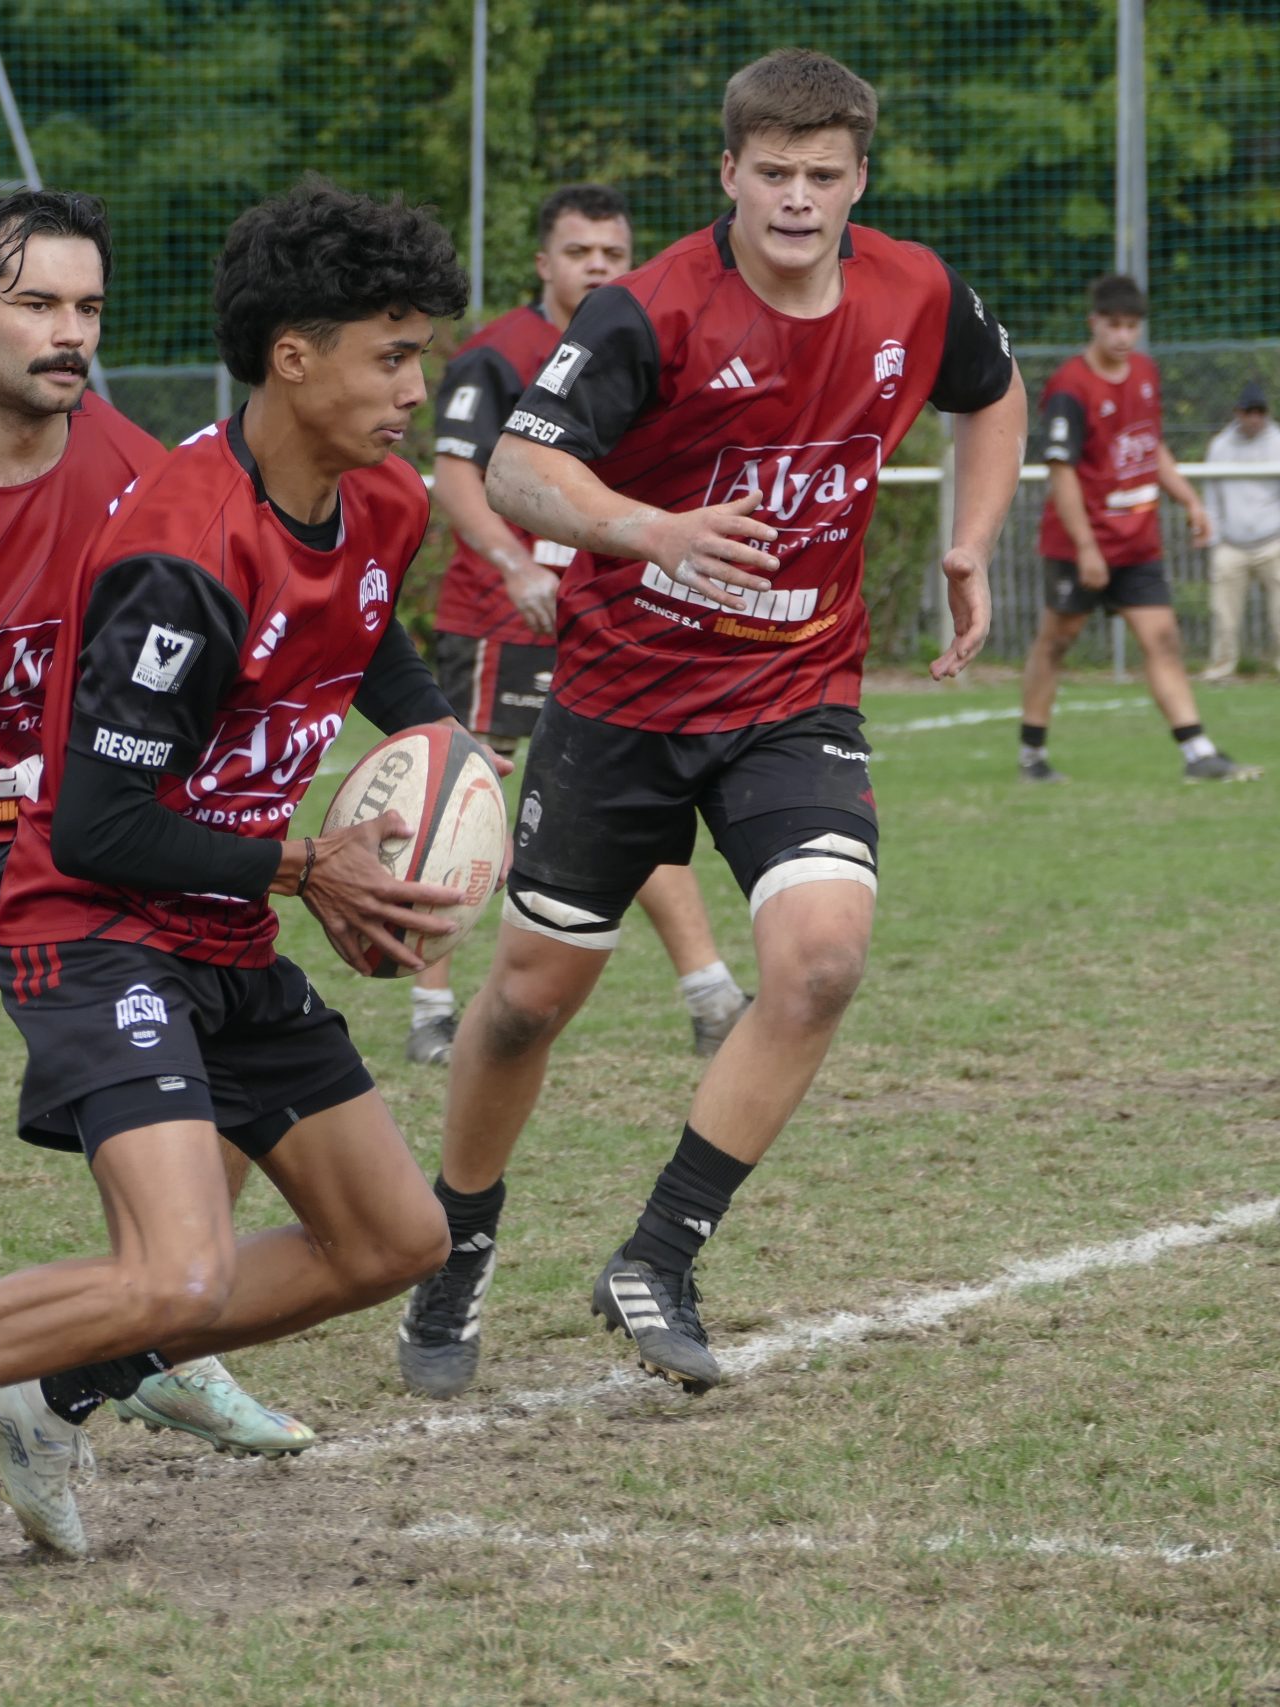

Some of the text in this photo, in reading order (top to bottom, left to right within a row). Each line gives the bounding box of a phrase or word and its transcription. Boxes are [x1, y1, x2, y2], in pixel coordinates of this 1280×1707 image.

[634, 597, 681, 622] FRANCE
[93, 727, 173, 767] RESPECT
[182, 807, 237, 826] NDS
[115, 994, 169, 1031] RCSR
